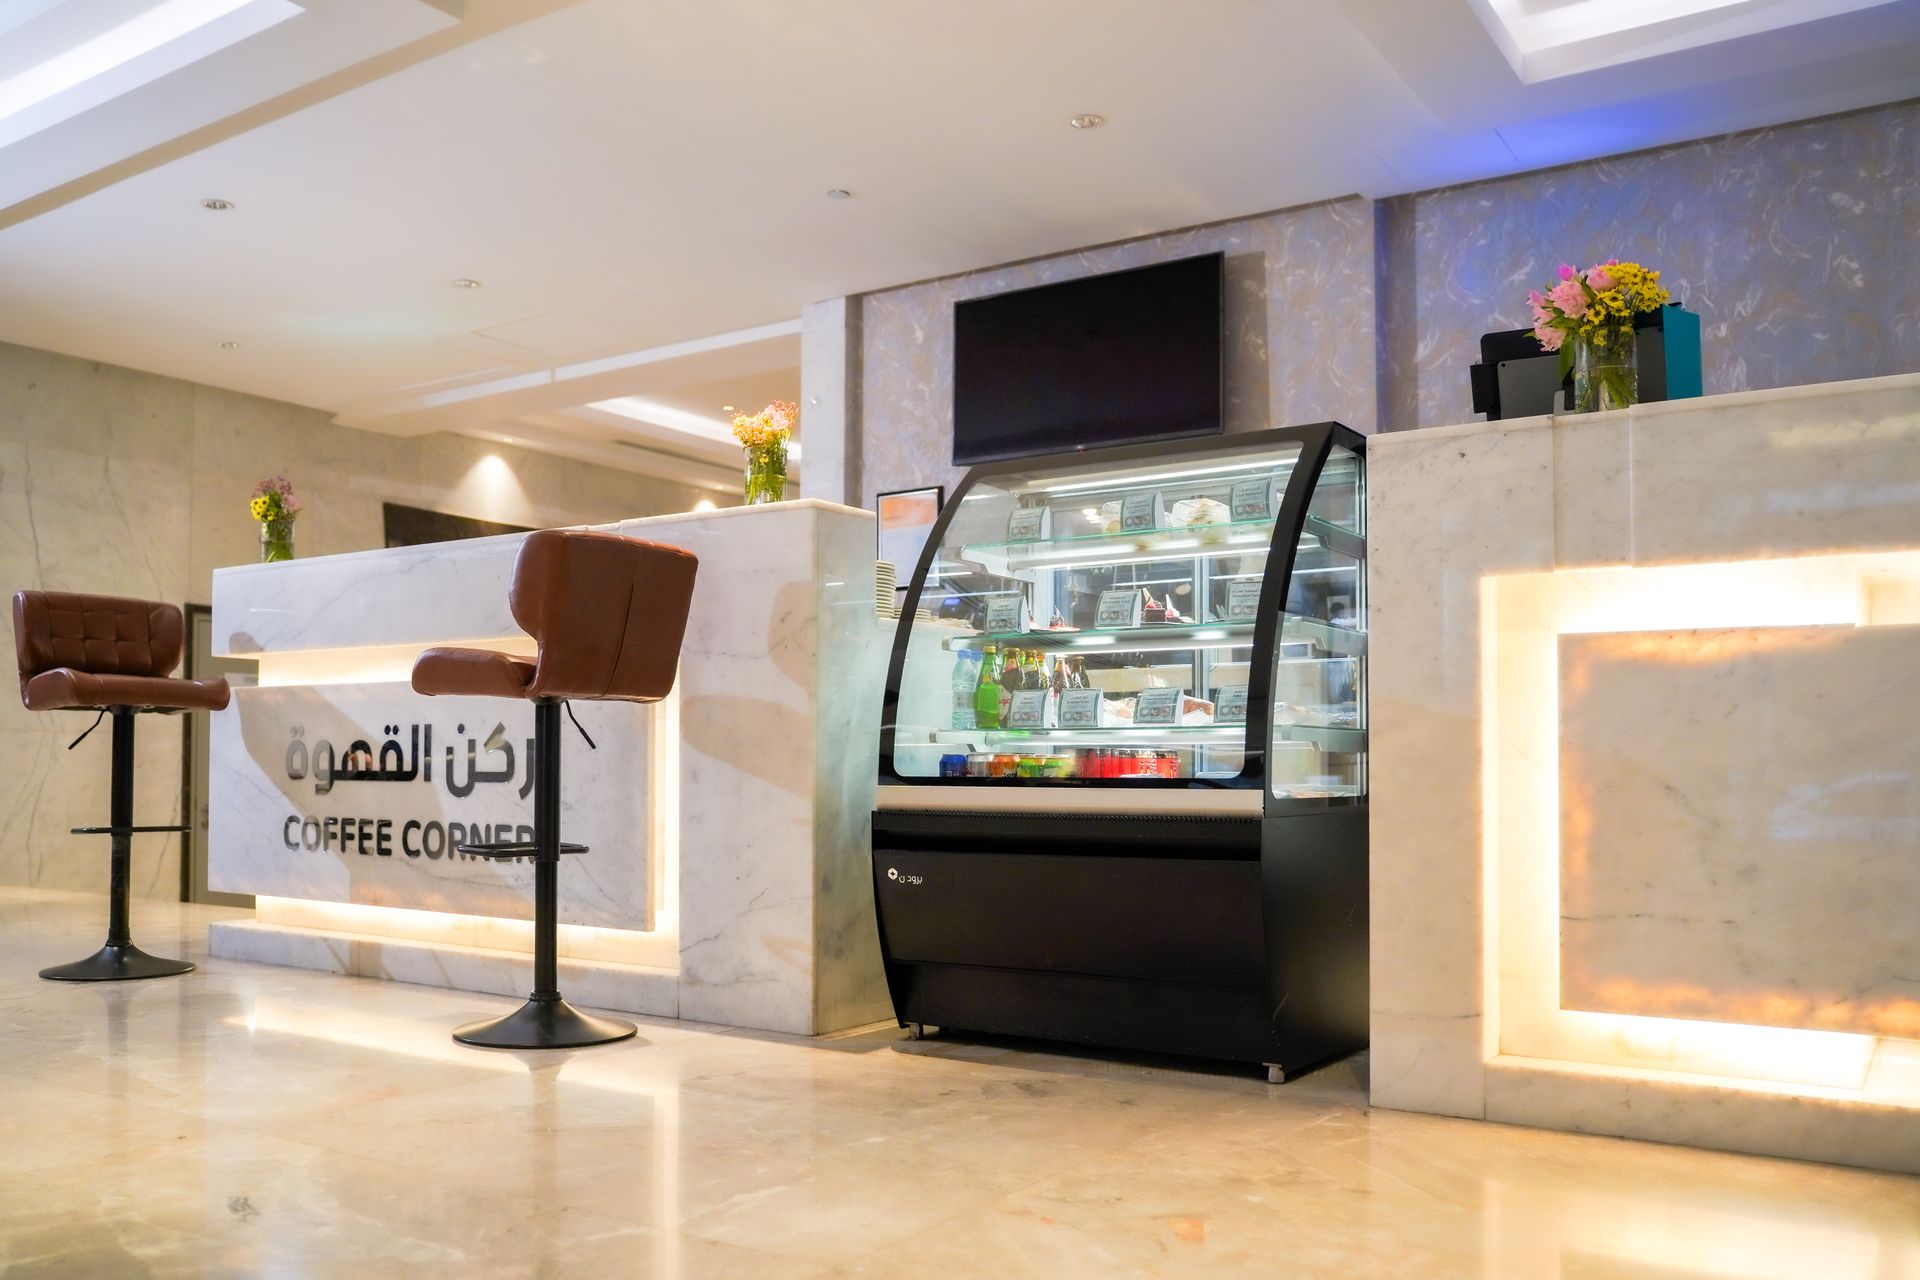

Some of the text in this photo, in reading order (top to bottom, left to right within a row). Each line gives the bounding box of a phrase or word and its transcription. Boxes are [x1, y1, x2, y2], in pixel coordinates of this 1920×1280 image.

[285, 722, 535, 800] ركن القهوة
[283, 815, 535, 864] COFFEE CORNER
